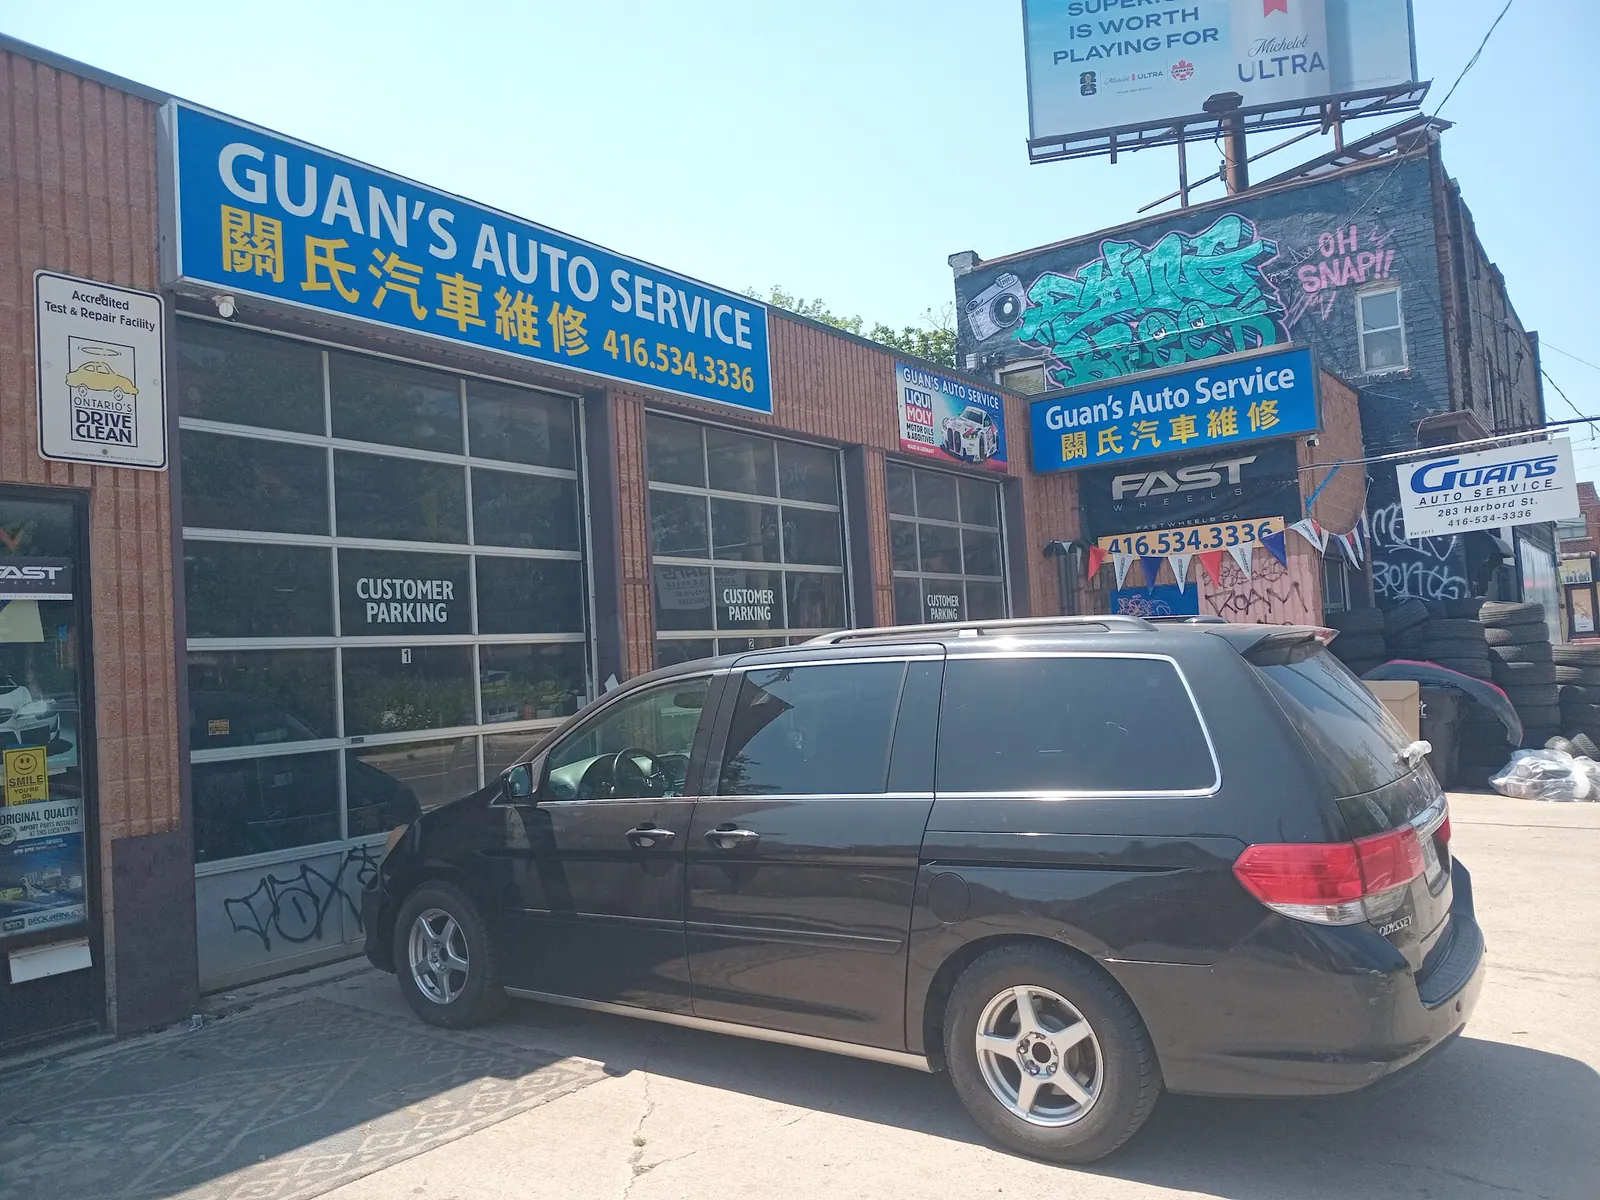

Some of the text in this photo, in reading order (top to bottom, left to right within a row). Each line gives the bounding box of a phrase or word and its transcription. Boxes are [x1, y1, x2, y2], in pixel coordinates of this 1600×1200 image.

[1070, 7, 1199, 39] IS WORTH
[1054, 28, 1219, 65] PLAYING FOR
[1137, 71, 1163, 80] ULTRA
[1238, 52, 1325, 82] ULTRA
[218, 142, 752, 350] GUAN'S AUTO SERVICE
[1319, 225, 1357, 257] OH
[1298, 249, 1396, 293] SNAP!!
[71, 290, 130, 311] Accredited
[45, 301, 156, 332] Test & Repair Facility
[603, 329, 754, 393] 416.534.3336
[903, 367, 999, 409] GUAN'S AUTO SERVICE
[1046, 366, 1295, 430] Guan's Auto Service
[74, 397, 132, 413] ONTARIO'S
[905, 389, 931, 409] LIQUI
[76, 409, 131, 429] DRIVE
[906, 406, 932, 425] MOLY
[75, 424, 132, 443] CLEAN
[906, 422, 934, 436] MOTOR OILS
[912, 432, 935, 445] ADDITIVES
[1112, 455, 1257, 500] FAST
[1113, 488, 1242, 511] WHEELS
[1419, 479, 1553, 506] AUTO SERVICE
[1438, 497, 1538, 517] 283 Harbord St.
[1448, 509, 1532, 527] 416-534-3336
[1108, 521, 1272, 555] 416.534.3336
[0, 566, 63, 580] AST
[356, 577, 454, 600] CUSTOMER
[723, 588, 774, 604] CUSTOMER
[927, 594, 959, 607] CUSTOMER
[366, 602, 448, 623] PARKING
[728, 606, 771, 621] PARKING
[930, 608, 958, 620] PARKING
[403, 649, 410, 663] 1
[9, 775, 44, 787] SMILE
[0, 806, 79, 826] ORIGINAL QUALITY
[20, 824, 39, 832] IMPORT
[48, 826, 70, 835] LOCATION
